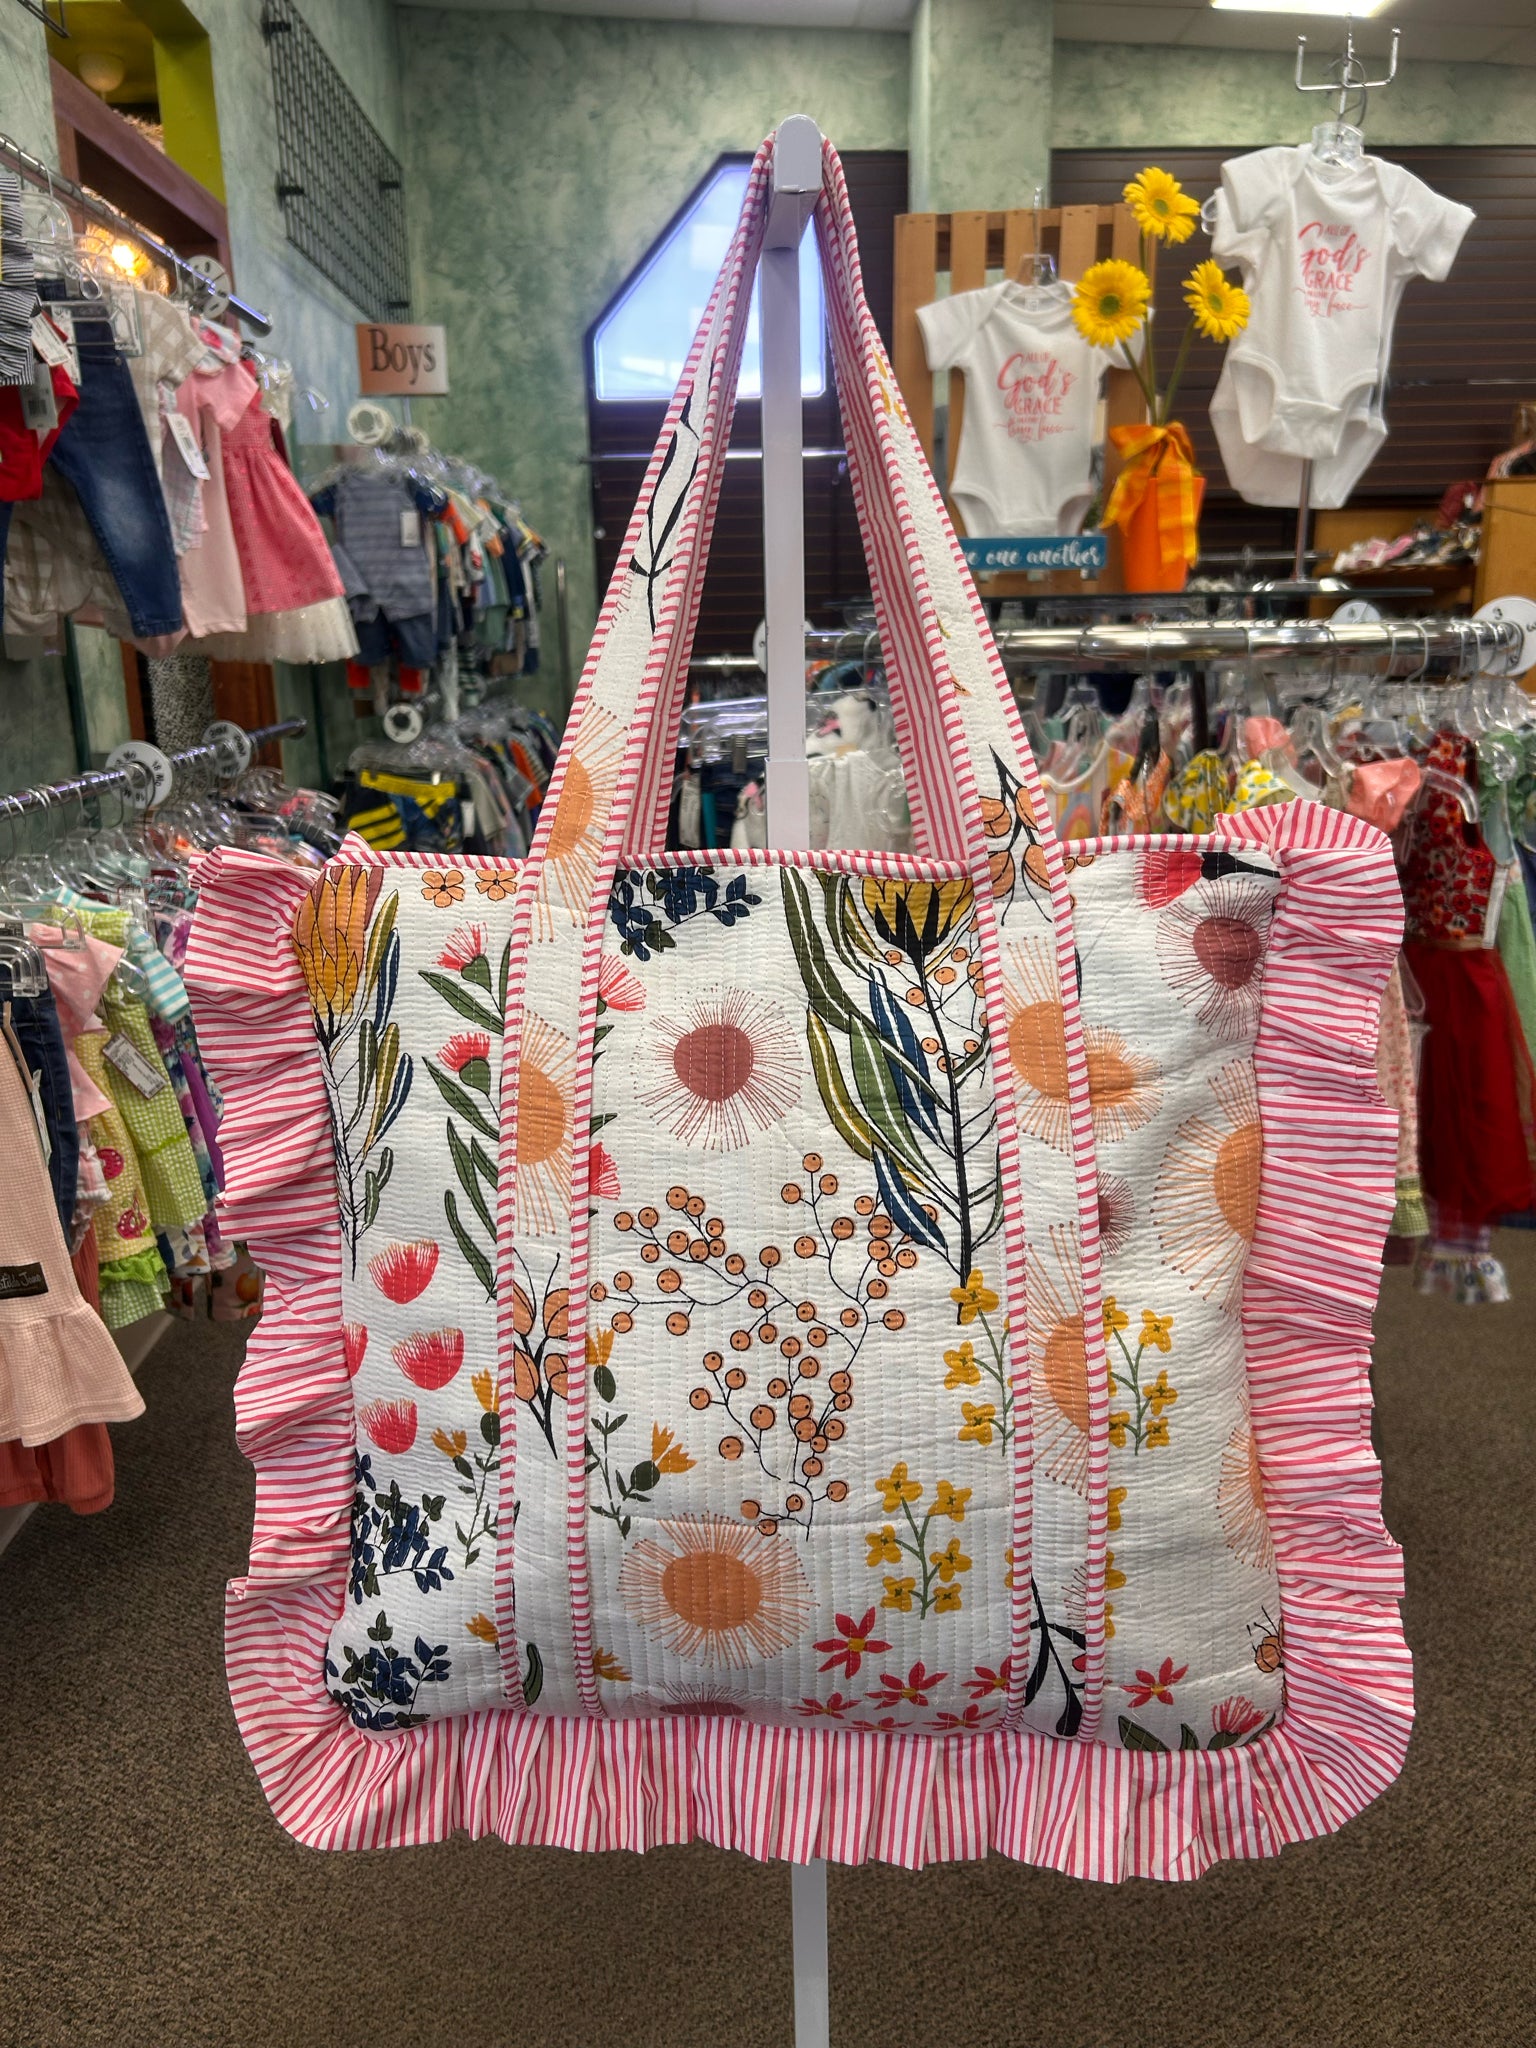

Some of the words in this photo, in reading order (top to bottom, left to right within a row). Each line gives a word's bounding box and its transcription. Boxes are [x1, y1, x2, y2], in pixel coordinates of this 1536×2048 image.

[1304, 271, 1353, 292] GRACE
[367, 328, 436, 385] Boys
[997, 352, 1078, 409] God's
[1014, 397, 1063, 415] GRACE
[985, 549, 1020, 567] one
[1026, 539, 1099, 567] another
